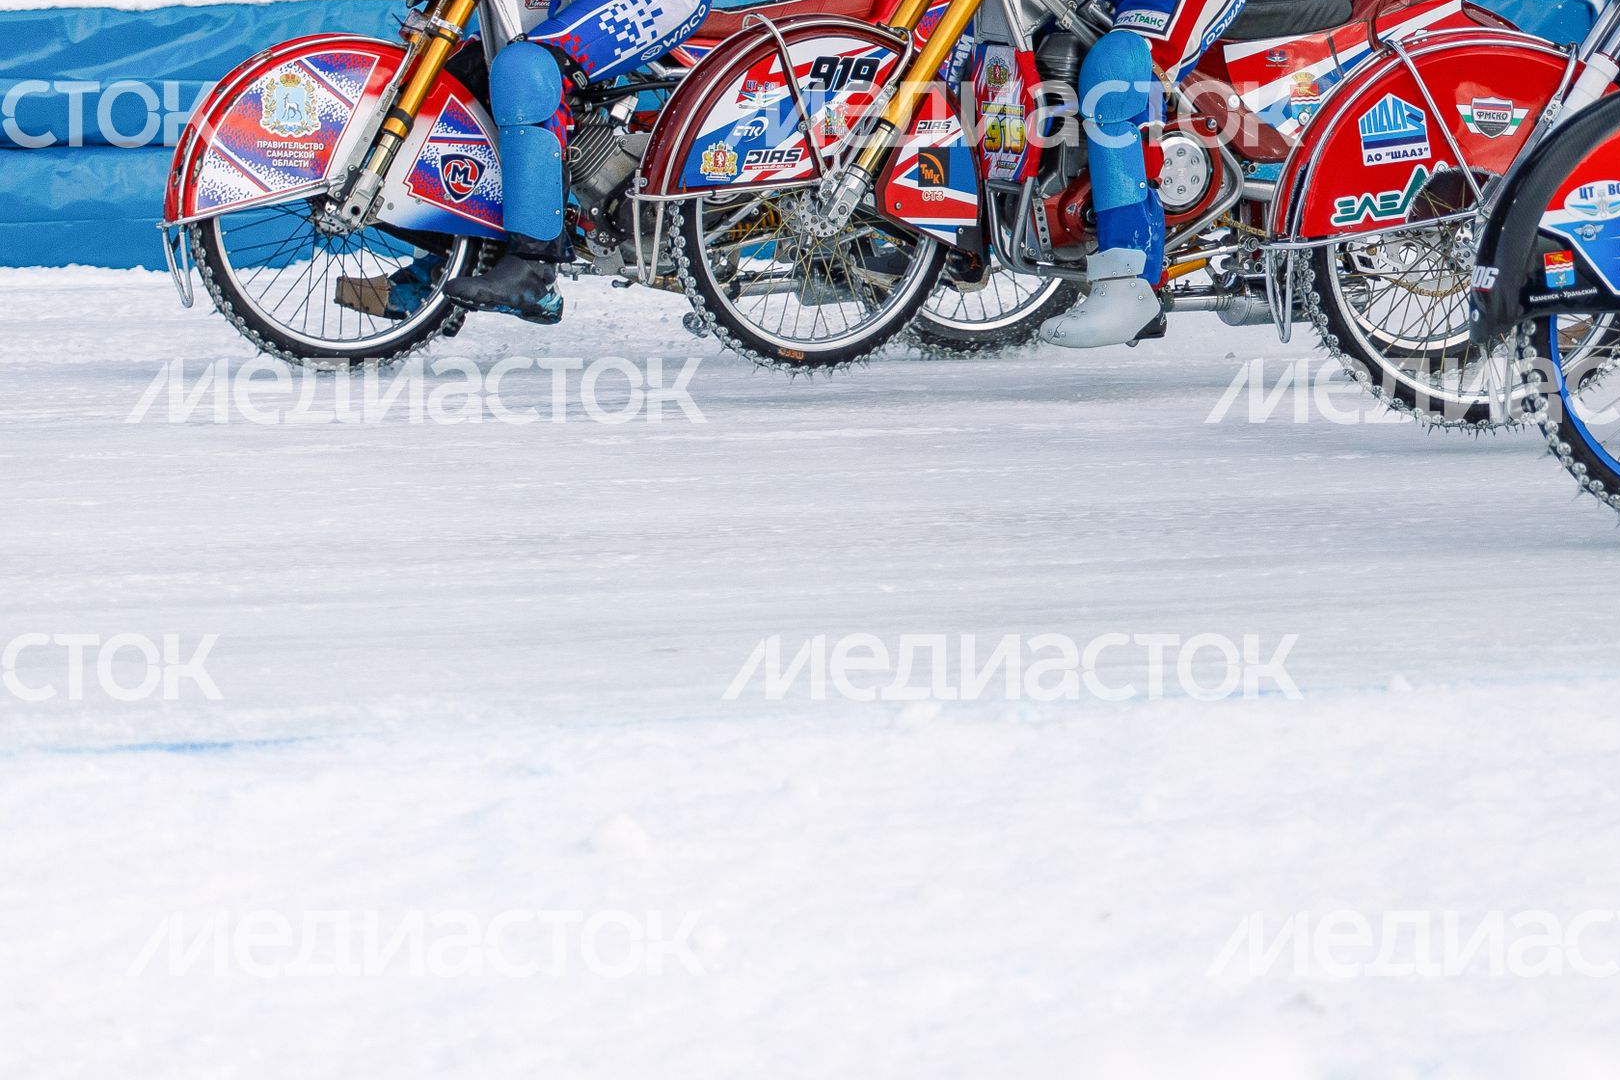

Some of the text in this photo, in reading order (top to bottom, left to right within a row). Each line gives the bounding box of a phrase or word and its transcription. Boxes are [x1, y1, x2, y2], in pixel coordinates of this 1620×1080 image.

[662, 4, 706, 47] WACO
[804, 56, 881, 92] 919
[1475, 111, 1509, 121] ФМСКО
[984, 116, 1026, 155] 919
[256, 140, 325, 152] ПРАВИТЕЛЬСТВО
[265, 149, 315, 160] САМАРСКОЙ
[1366, 150, 1383, 163] АО
[271, 159, 310, 168] ОБЛАСТИ
[920, 163, 940, 184] ТМК
[1579, 186, 1594, 201] ЦТ
[1529, 293, 1560, 303] Каменск
[1563, 287, 1598, 299] Уральский
